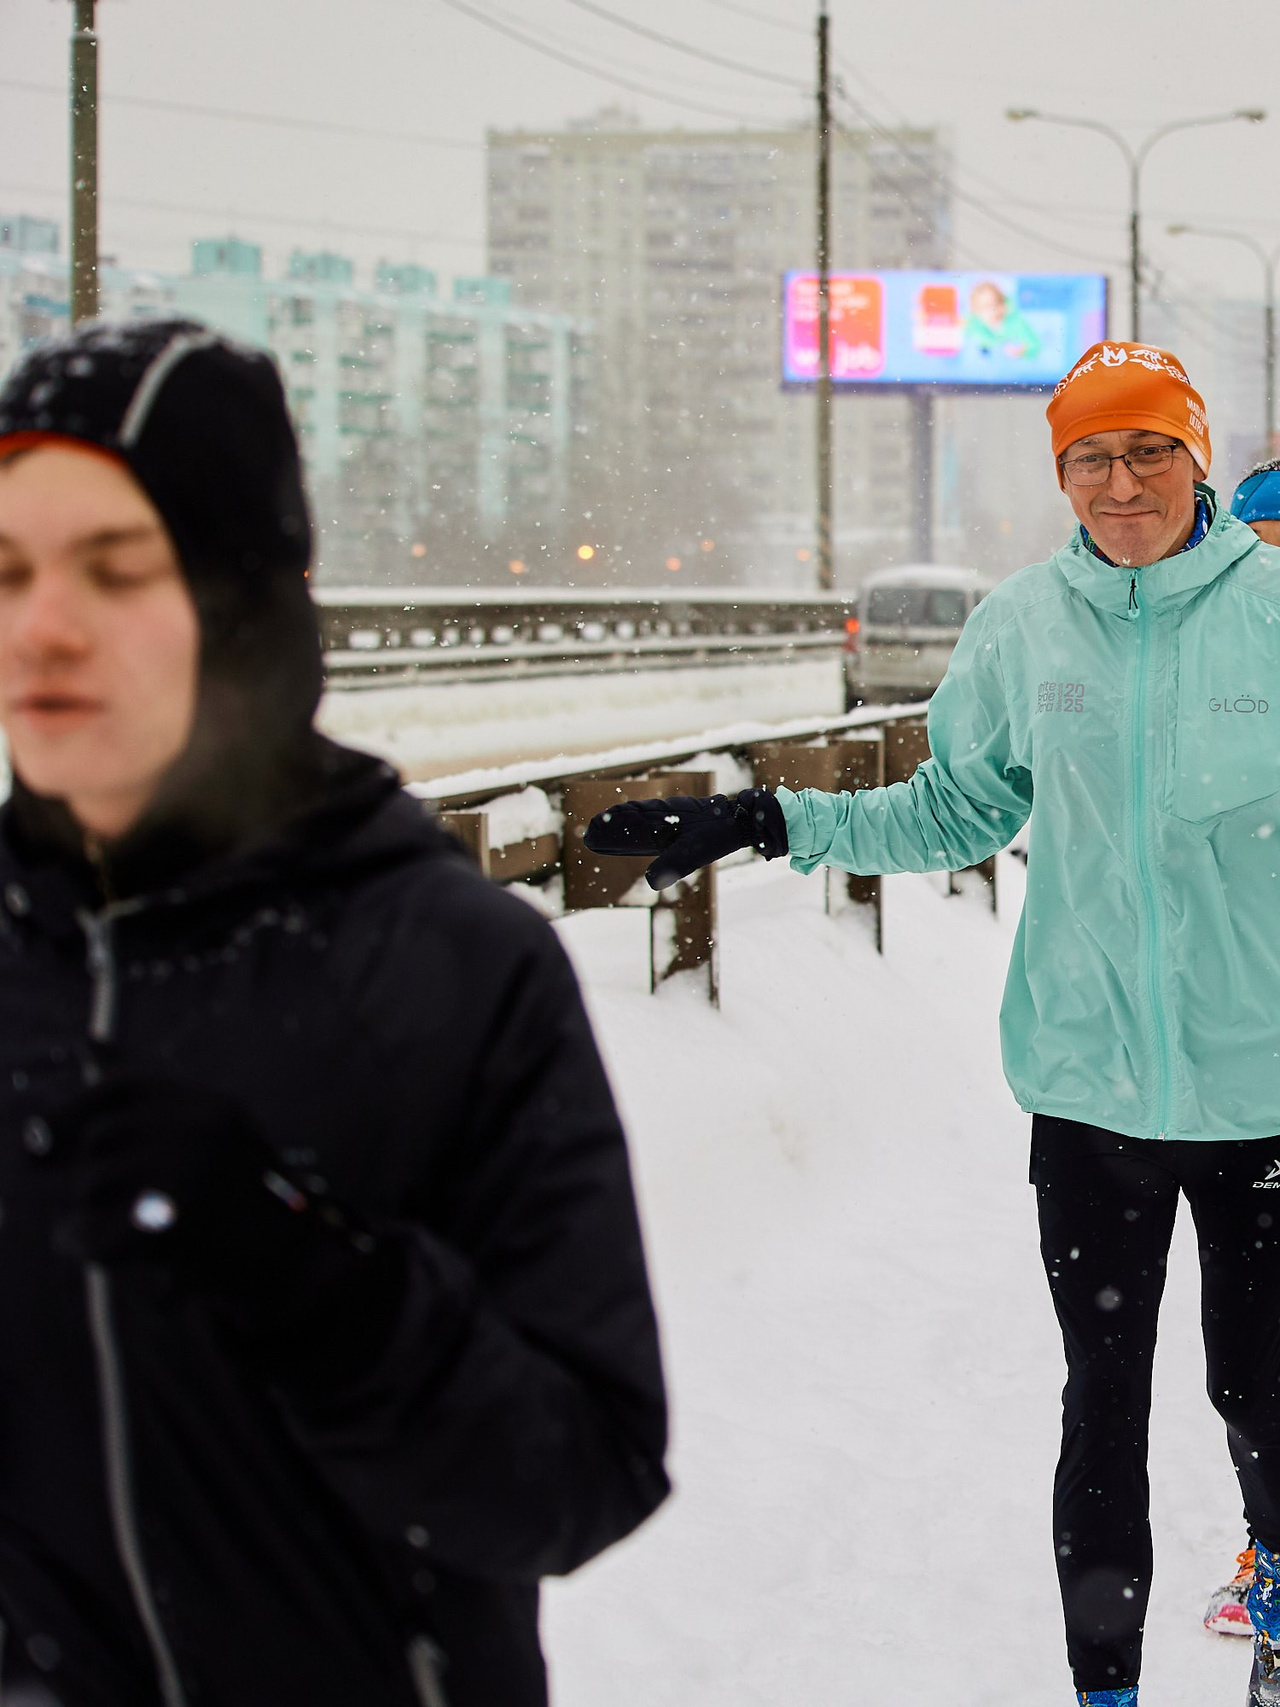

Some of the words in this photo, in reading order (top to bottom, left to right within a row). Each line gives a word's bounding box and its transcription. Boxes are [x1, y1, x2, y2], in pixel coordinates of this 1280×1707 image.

[1189, 412, 1204, 438] ULTRA
[1064, 683, 1085, 698] 20
[1063, 698, 1084, 713] 25
[1208, 694, 1269, 714] GLÖD
